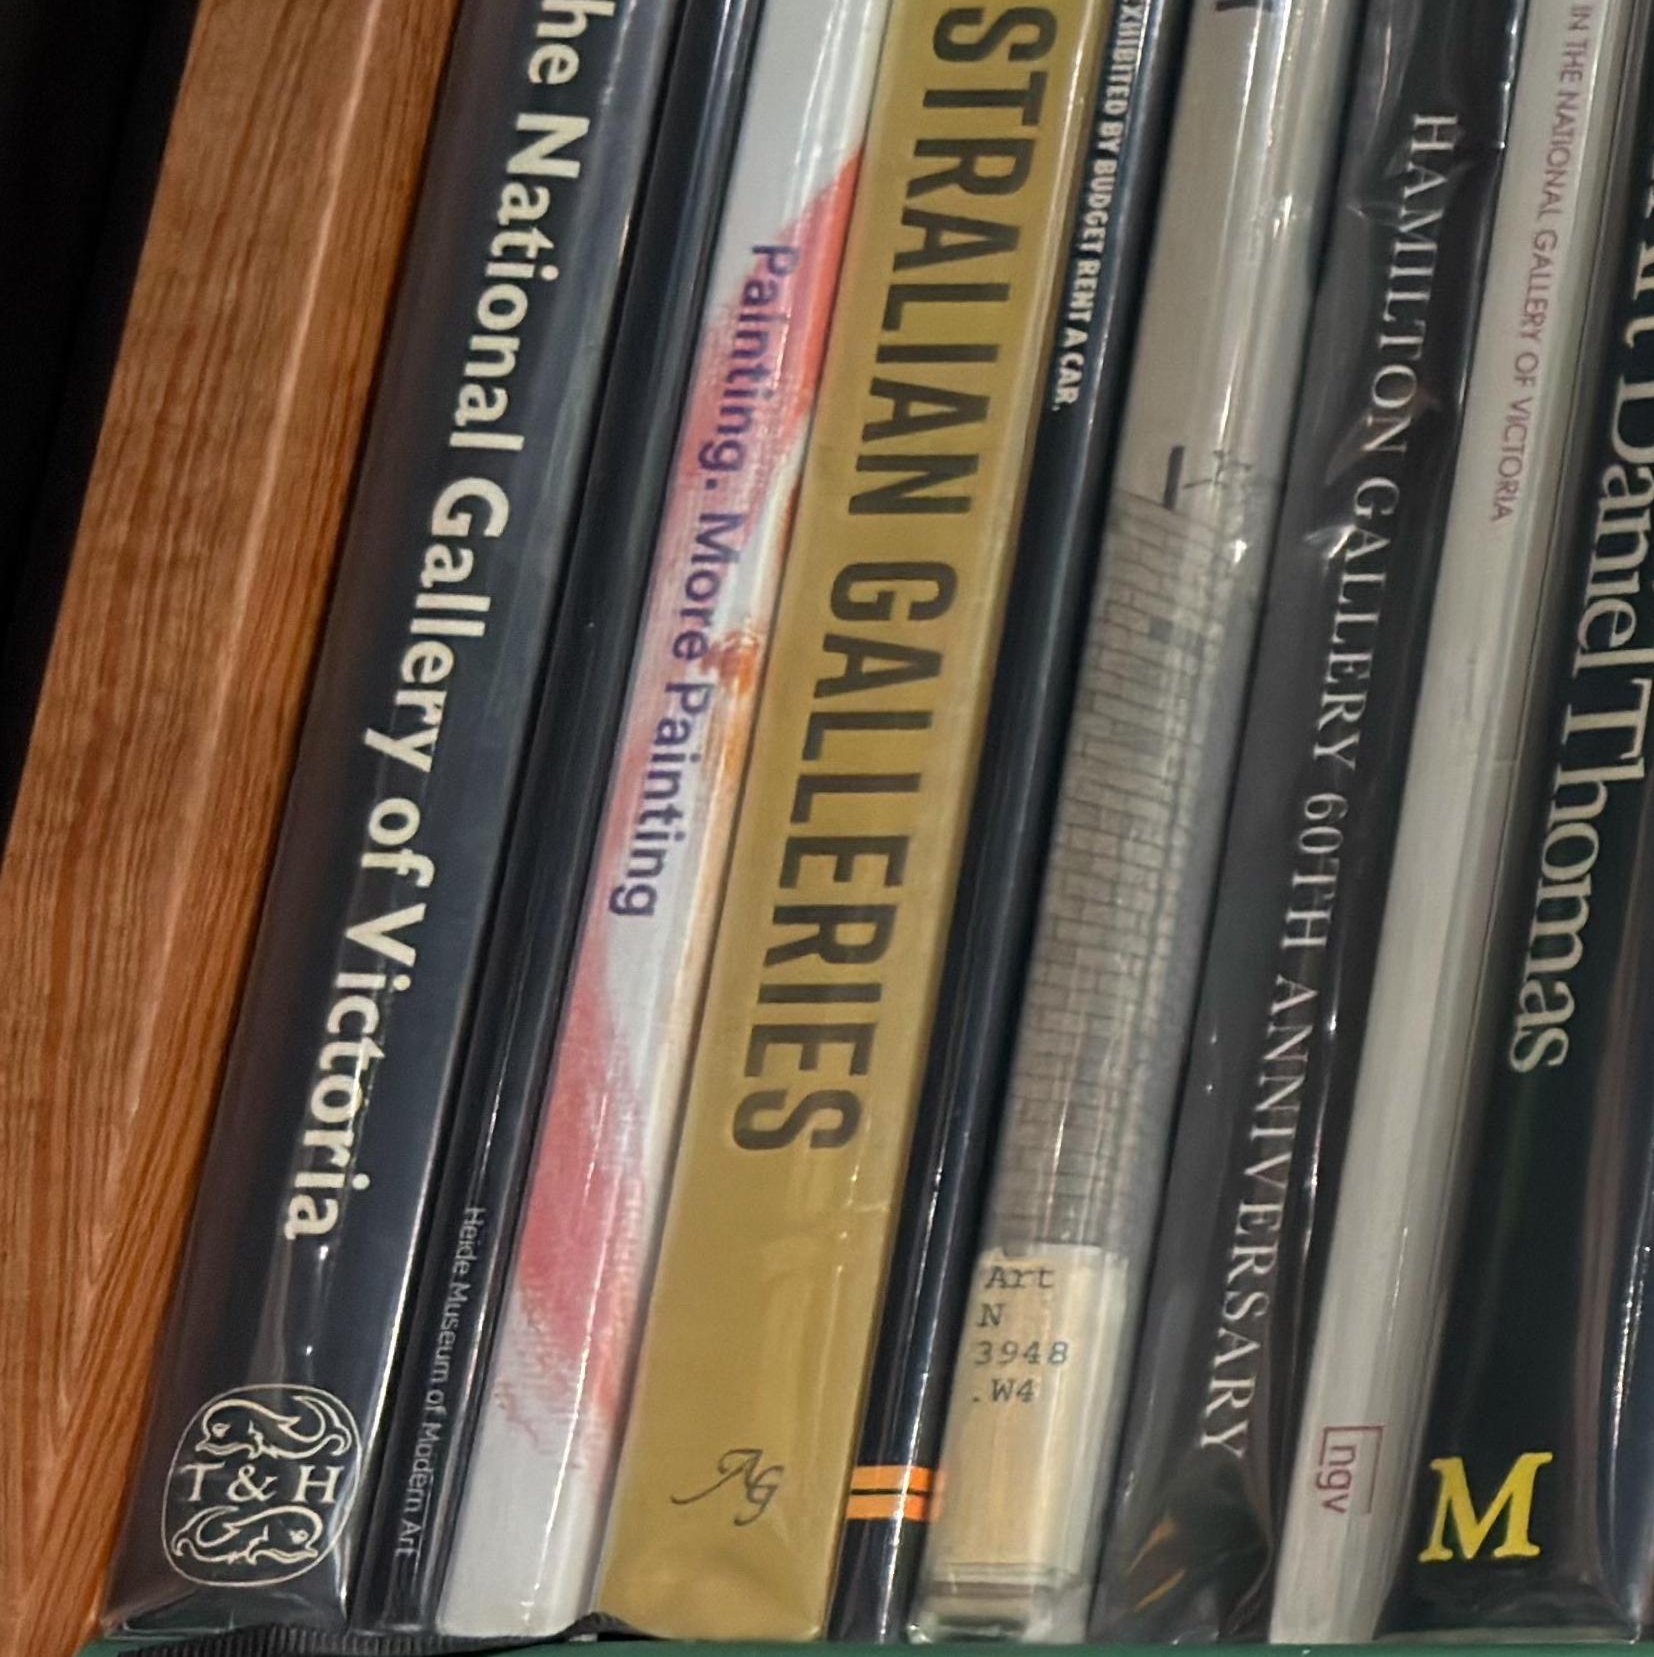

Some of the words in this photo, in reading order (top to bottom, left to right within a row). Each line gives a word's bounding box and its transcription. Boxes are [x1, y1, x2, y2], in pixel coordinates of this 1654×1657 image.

[1555, 40, 1589, 83] THE
[1535, 91, 1581, 220] NATIONAL
[450, 114, 595, 447] National
[1355, 113, 1459, 454] HAMILTON
[1517, 231, 1561, 340] GALLERY
[692, 243, 795, 492] Painting.
[1490, 396, 1536, 520] VICTORIA
[366, 476, 522, 772] Gallery
[667, 512, 746, 665] More
[1306, 476, 1401, 770] GALLERY
[360, 799, 457, 893] of
[616, 681, 715, 920] Painting
[730, 558, 957, 1150] GALLERIES
[1278, 791, 1352, 951] 60TH
[1510, 680, 1652, 1072] Thomas
[289, 906, 436, 1240] Victoria
[451, 1206, 487, 1276] Heide
[984, 1265, 1054, 1290] Art
[1200, 972, 1323, 1458] ANNIVERSARY
[430, 1282, 472, 1383] Museum
[395, 1518, 426, 1557] Art
[404, 1422, 445, 1512] Modern
[1419, 1451, 1556, 1562] M
